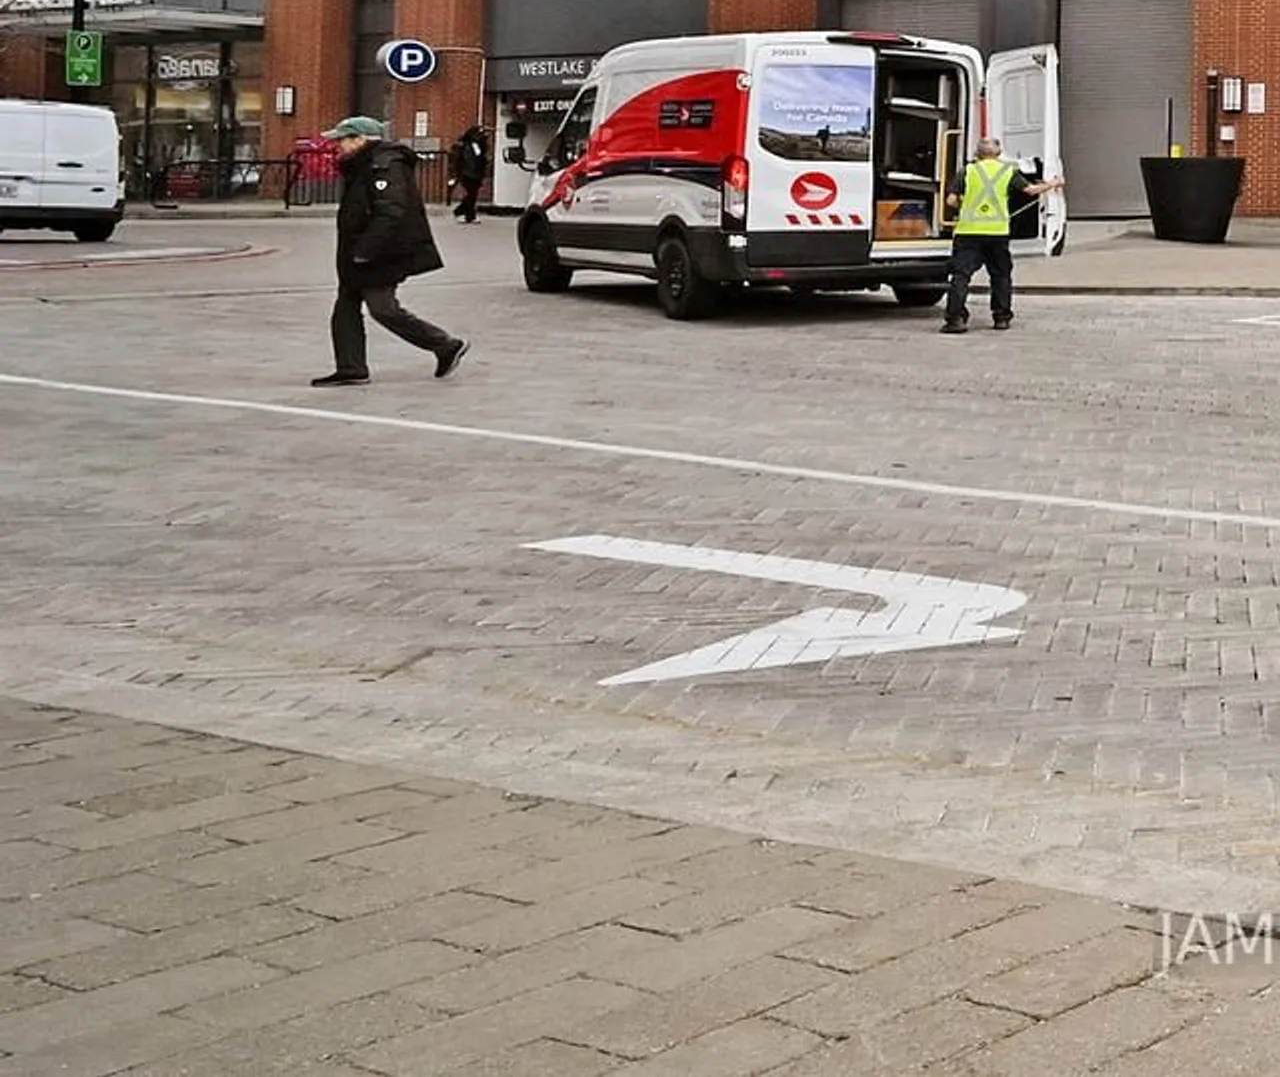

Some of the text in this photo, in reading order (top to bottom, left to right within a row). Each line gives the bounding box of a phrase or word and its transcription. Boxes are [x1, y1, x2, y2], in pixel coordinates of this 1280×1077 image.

[401, 49, 424, 72] P
[519, 59, 584, 76] WESTLAKE
[533, 101, 575, 112] EXIT ON
